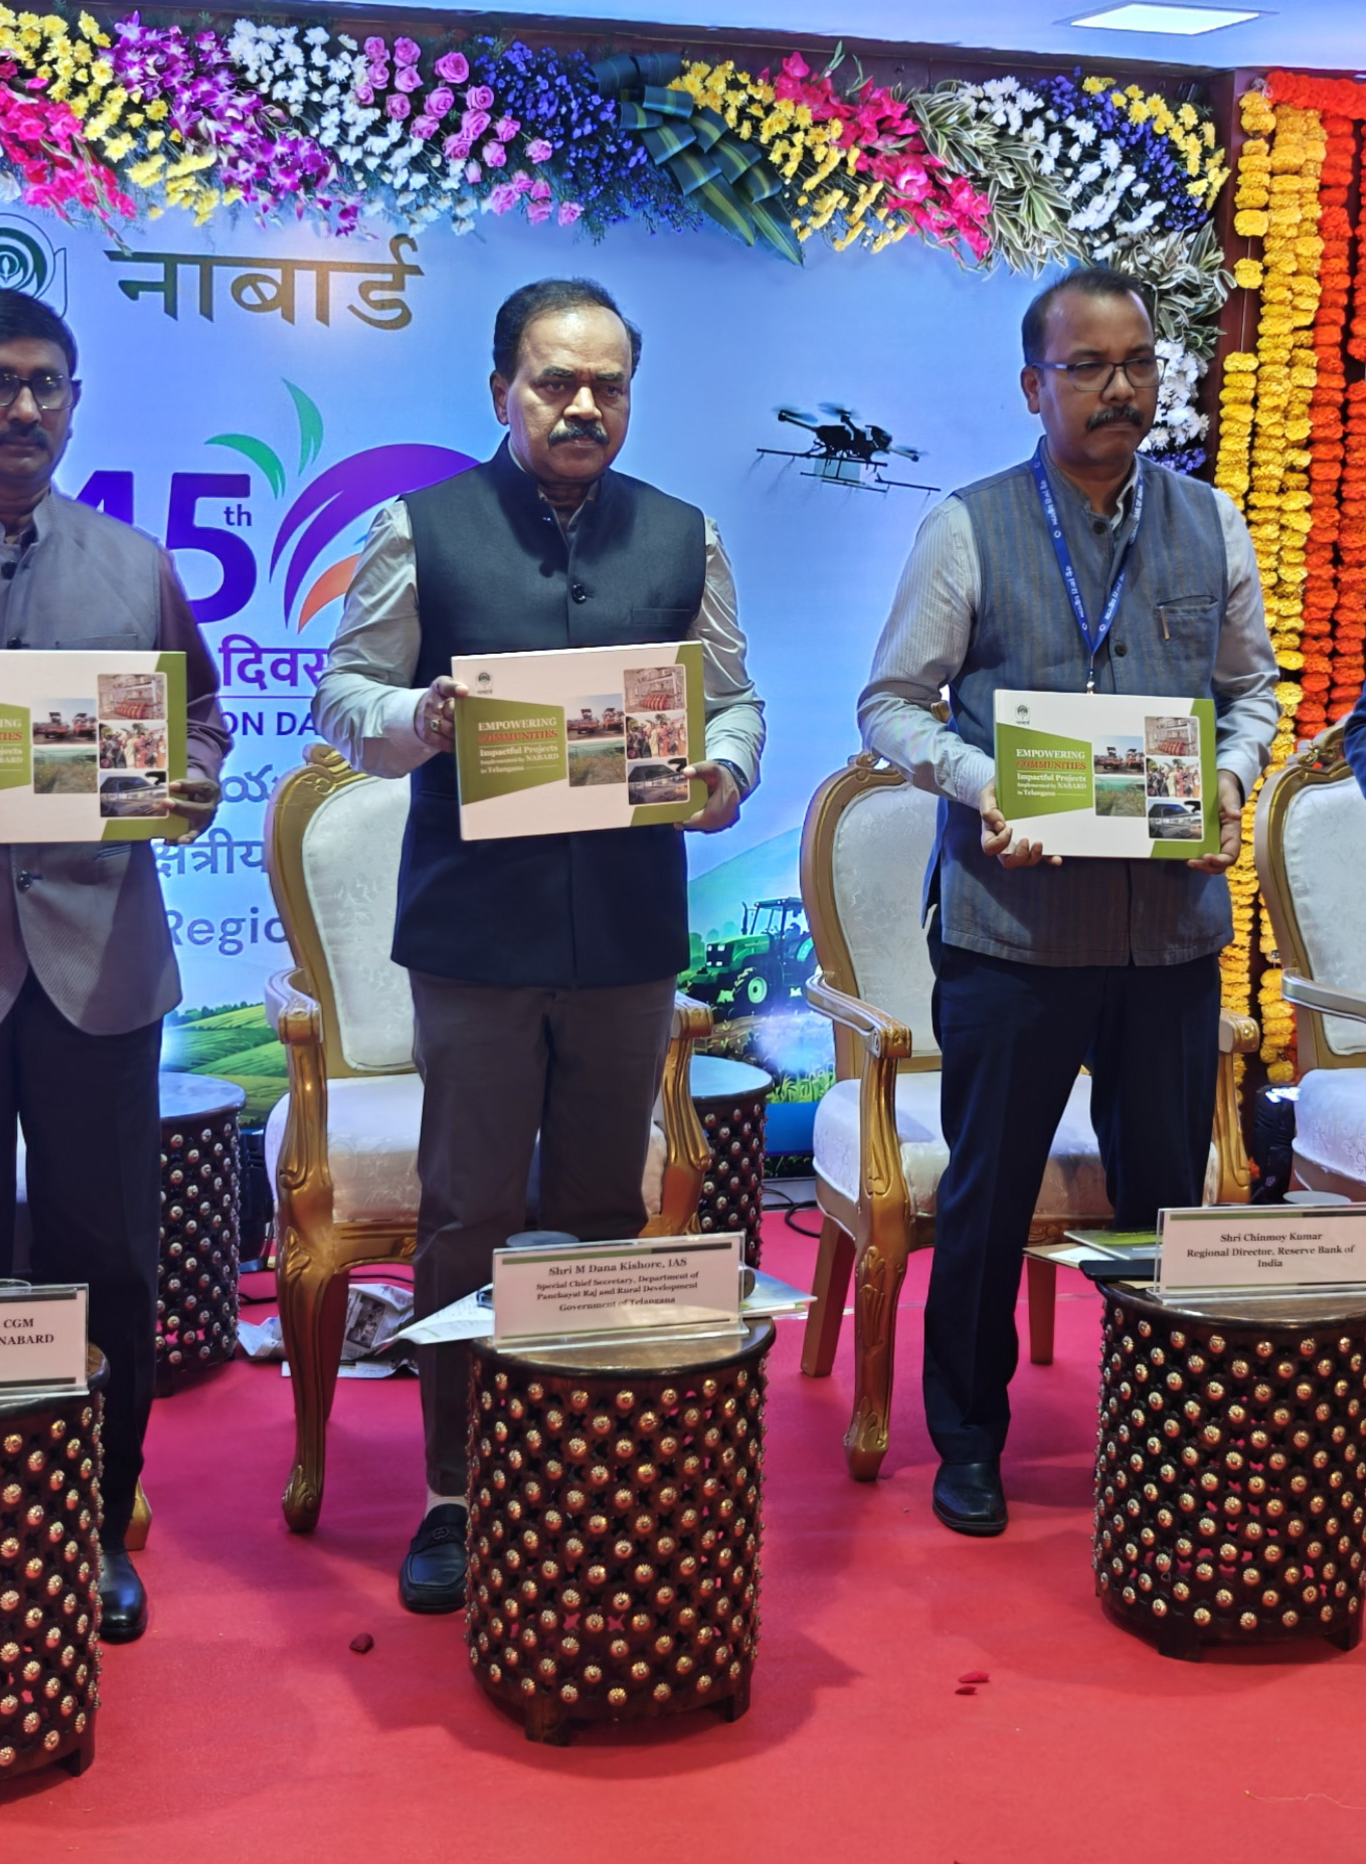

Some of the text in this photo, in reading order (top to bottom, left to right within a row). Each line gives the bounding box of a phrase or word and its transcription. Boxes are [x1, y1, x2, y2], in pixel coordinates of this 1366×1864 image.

[103, 233, 424, 331] नाबार्ड
[478, 717, 556, 731] EMPOWERING
[480, 745, 558, 757] Impactful Projects
[1016, 749, 1085, 759] EMPOWERING
[1017, 772, 1086, 782] Impactful Projects
[1220, 1234, 1241, 1242] Shri
[1243, 1233, 1286, 1242] Chinmoy
[1187, 1248, 1229, 1258] Regional
[1277, 1247, 1315, 1256] Reserve
[1318, 1245, 1342, 1254] Bank
[1344, 1245, 1355, 1253] of
[548, 1258, 687, 1276] Shri M Dana Kishore, IAS
[1257, 1259, 1283, 1268] India
[536, 1281, 567, 1291] Special
[569, 1279, 591, 1288] Chief
[638, 1274, 688, 1283] Department
[690, 1271, 699, 1279] of
[583, 1289, 597, 1298] Raj
[599, 1288, 615, 1296] and
[617, 1285, 641, 1294] Rural
[643, 1282, 698, 1293] Development
[559, 1301, 616, 1312] Government
[629, 1296, 675, 1305] Telangana
[3, 1318, 34, 1328] CGM
